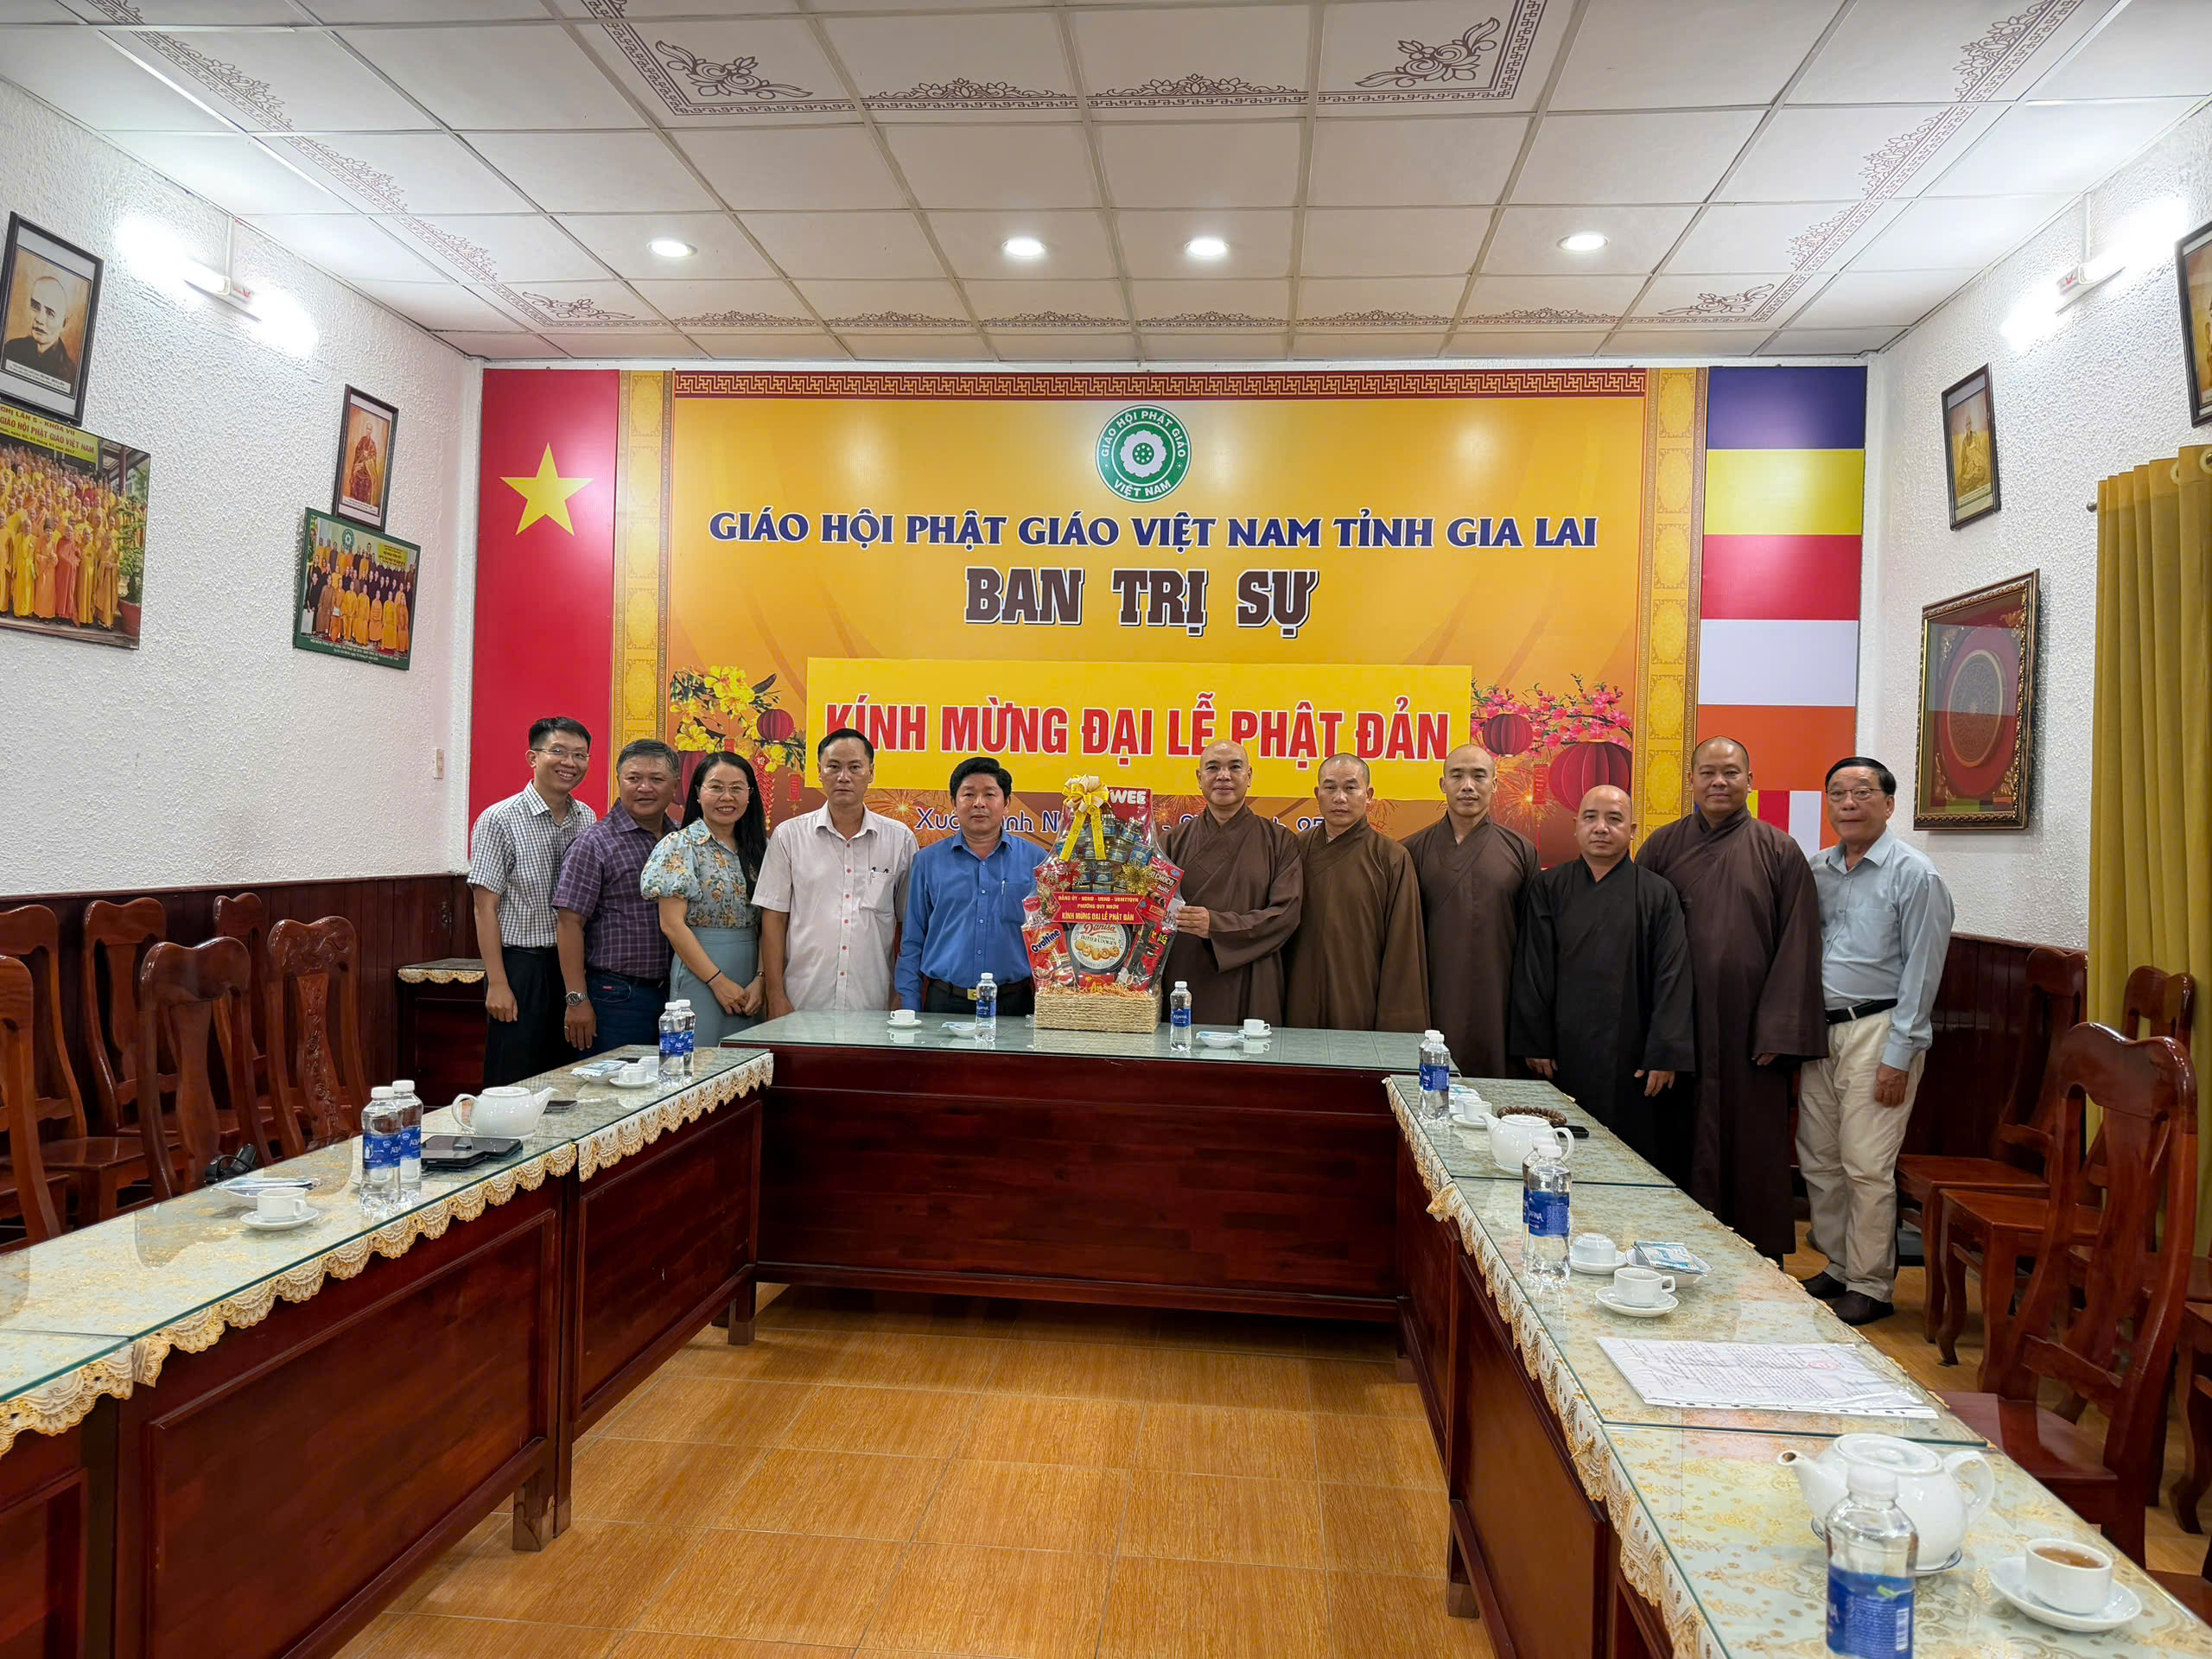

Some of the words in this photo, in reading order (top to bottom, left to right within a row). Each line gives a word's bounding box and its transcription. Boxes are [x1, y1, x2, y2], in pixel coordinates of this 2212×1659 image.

[1102, 429, 1116, 457] GIÁO
[1116, 411, 1137, 429] HỘI
[1141, 410, 1173, 428] PHẬT
[1172, 428, 1188, 457] GIÁO
[1114, 479, 1141, 498] VIỆT
[1145, 480, 1172, 497] NAM
[709, 506, 809, 543] GIÁO
[820, 508, 893, 550] HỘI
[905, 509, 1007, 550] PHẬT
[1017, 511, 1120, 547] GIÁO
[1132, 512, 1217, 554] VIỆT
[1227, 518, 1323, 548] NAM
[1332, 509, 1434, 548] TỈNH
[1446, 517, 1524, 548] GIA
[1534, 517, 1599, 548] LAI
[963, 567, 1084, 626] BAN
[1112, 569, 1209, 638] TRỊ
[1236, 569, 1319, 639] SỰ
[940, 696, 1069, 754] MỪNG
[1080, 707, 1154, 767] ĐẠI
[1167, 691, 1216, 757] LỄ
[1230, 701, 1344, 771] PHẬT
[1354, 696, 1450, 760] ĐẢN
[1031, 929, 1061, 954] Ovaltine
[1083, 923, 1116, 934] Danisa
